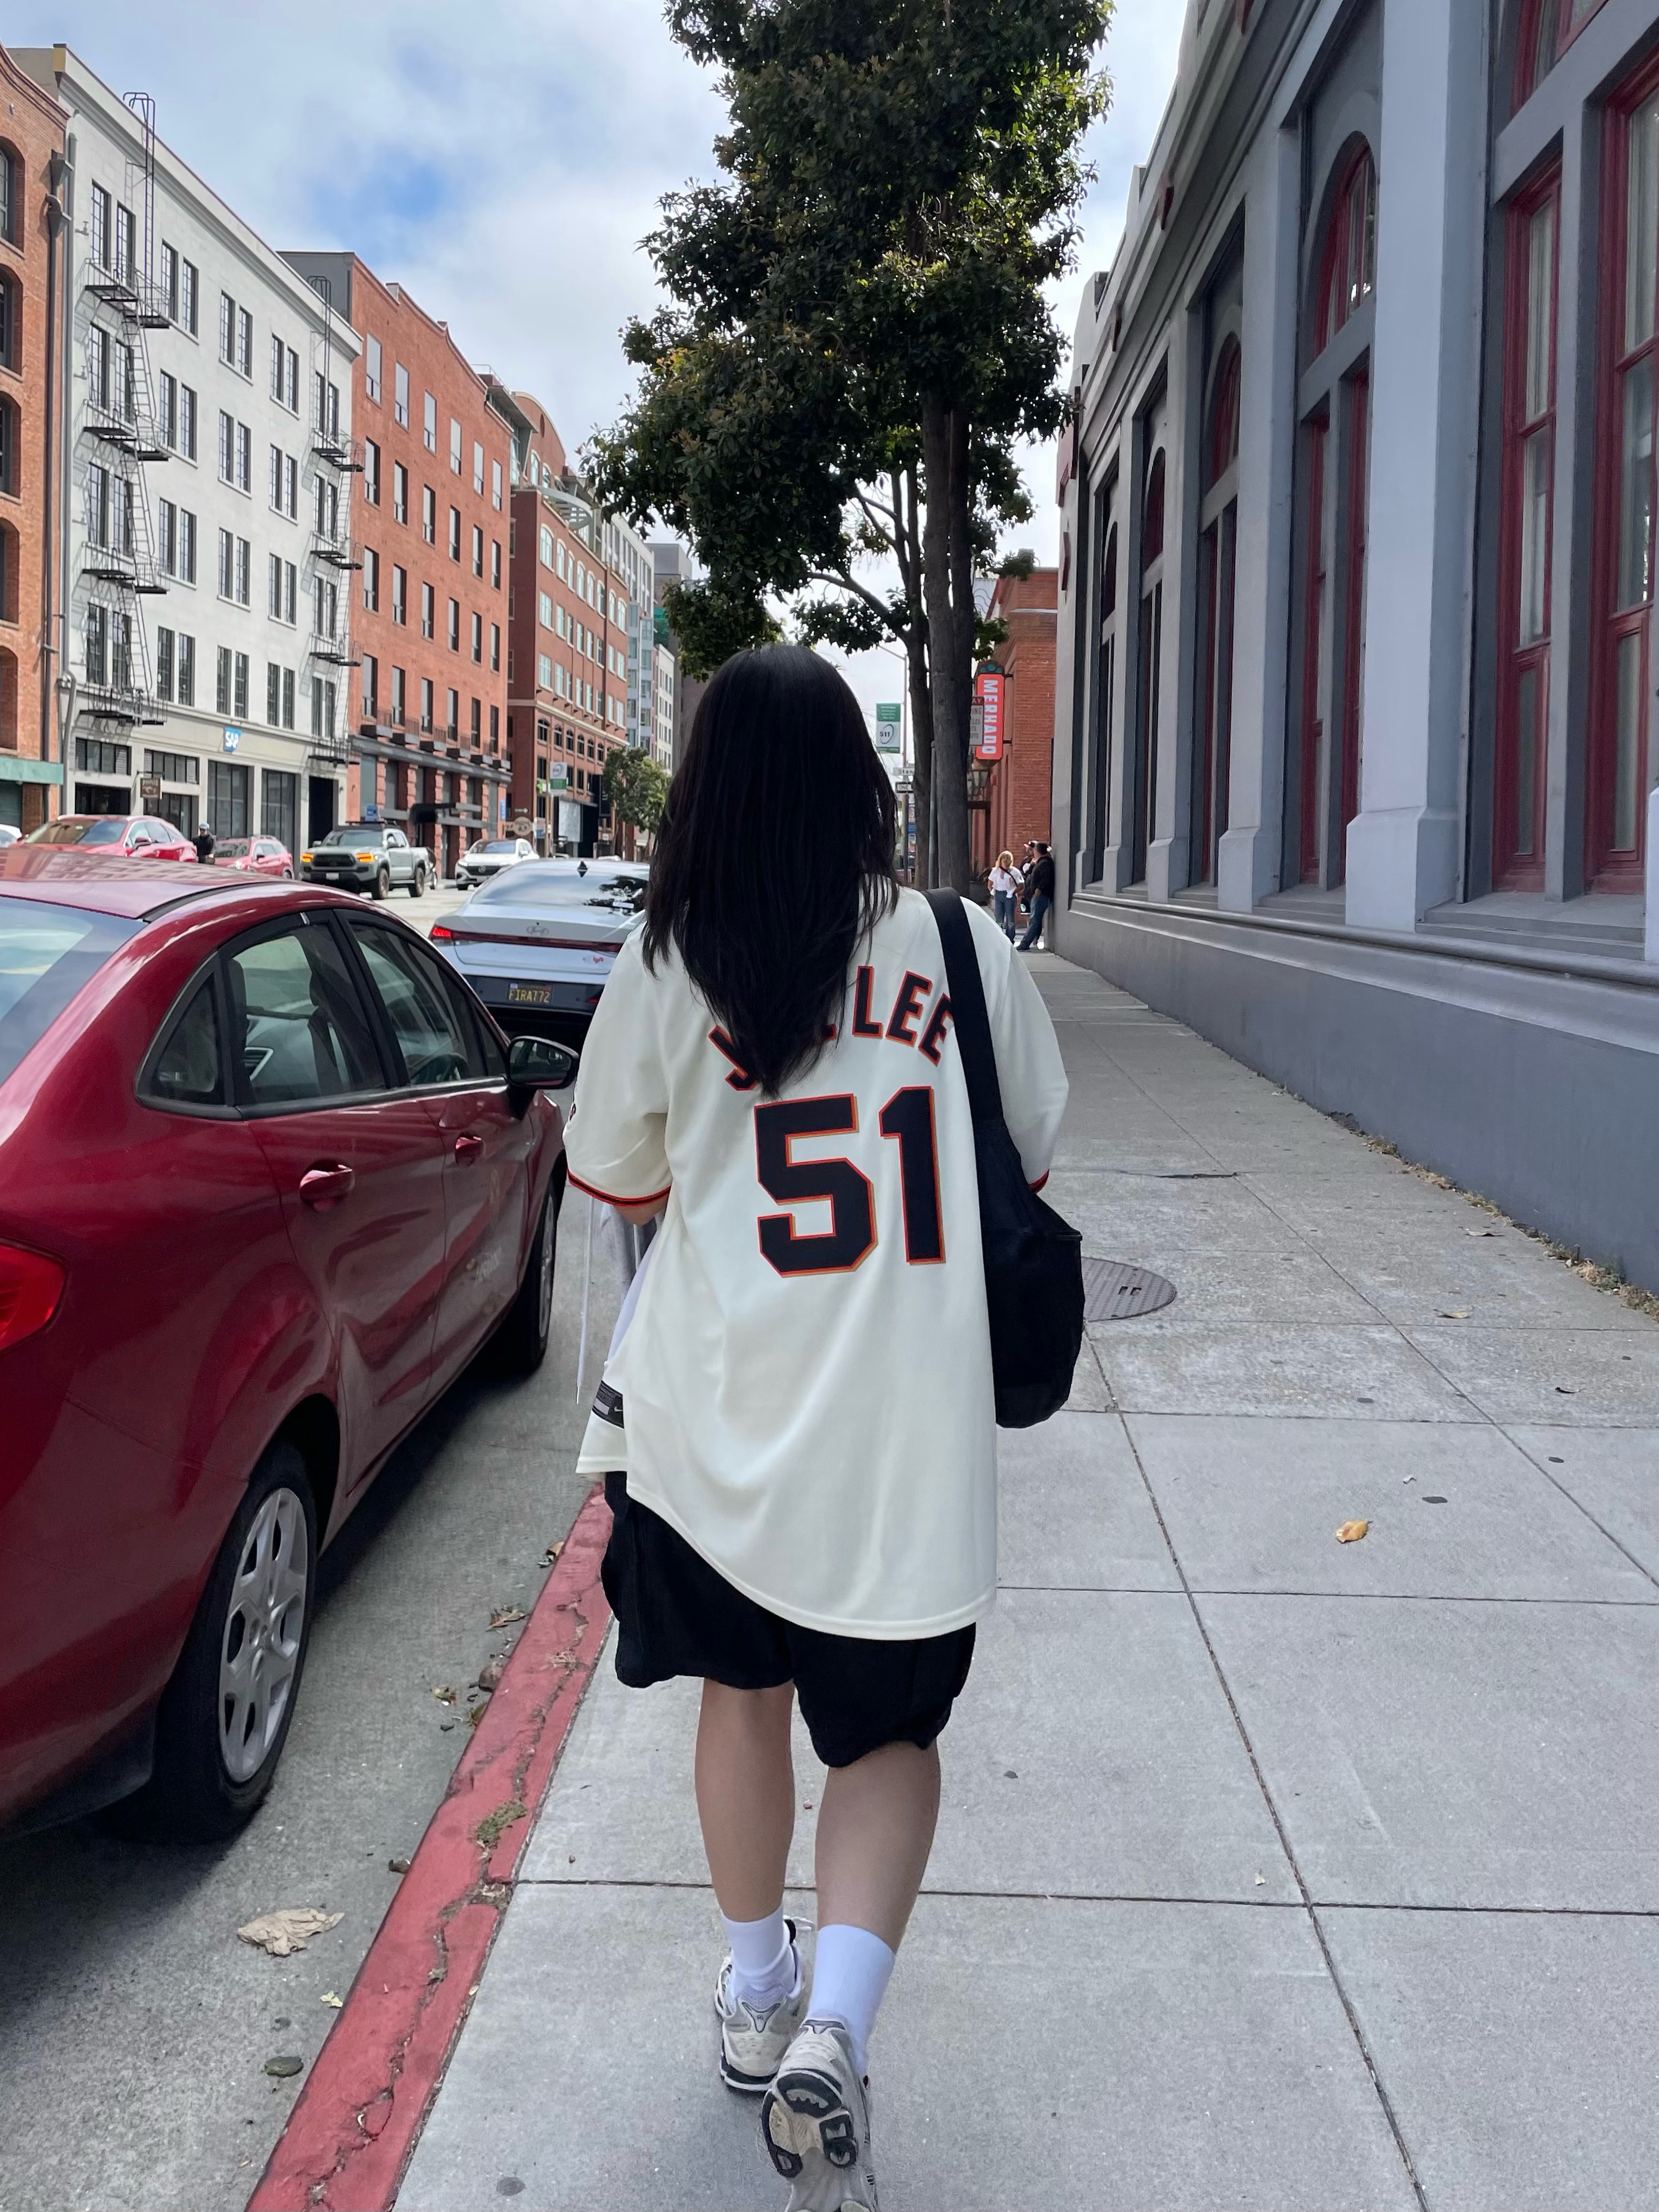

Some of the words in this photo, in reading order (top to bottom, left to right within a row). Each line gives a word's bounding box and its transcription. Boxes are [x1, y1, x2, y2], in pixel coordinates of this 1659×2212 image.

[225, 731, 239, 749] SAP
[509, 988, 550, 1003] FIRAT72
[852, 966, 955, 1067] LEE
[754, 1085, 946, 1278] 51
